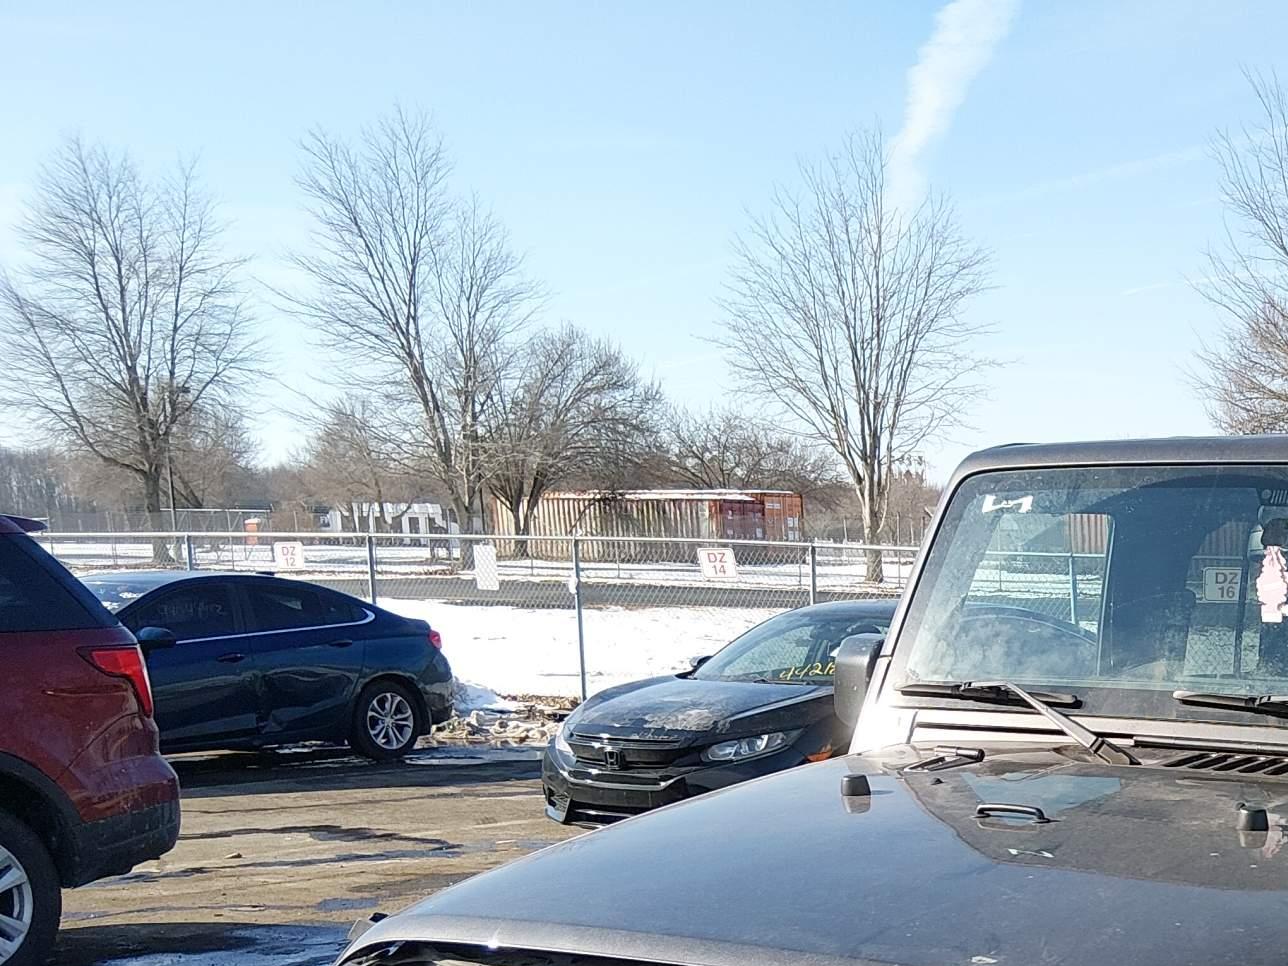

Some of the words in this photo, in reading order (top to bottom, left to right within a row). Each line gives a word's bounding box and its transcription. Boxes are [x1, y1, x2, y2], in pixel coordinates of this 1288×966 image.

[281, 546, 296, 556] DZ
[285, 557, 296, 567] 12
[707, 552, 727, 563] DZ
[711, 565, 726, 576] 14
[1215, 572, 1239, 585] DZ
[1217, 586, 1236, 599] 16
